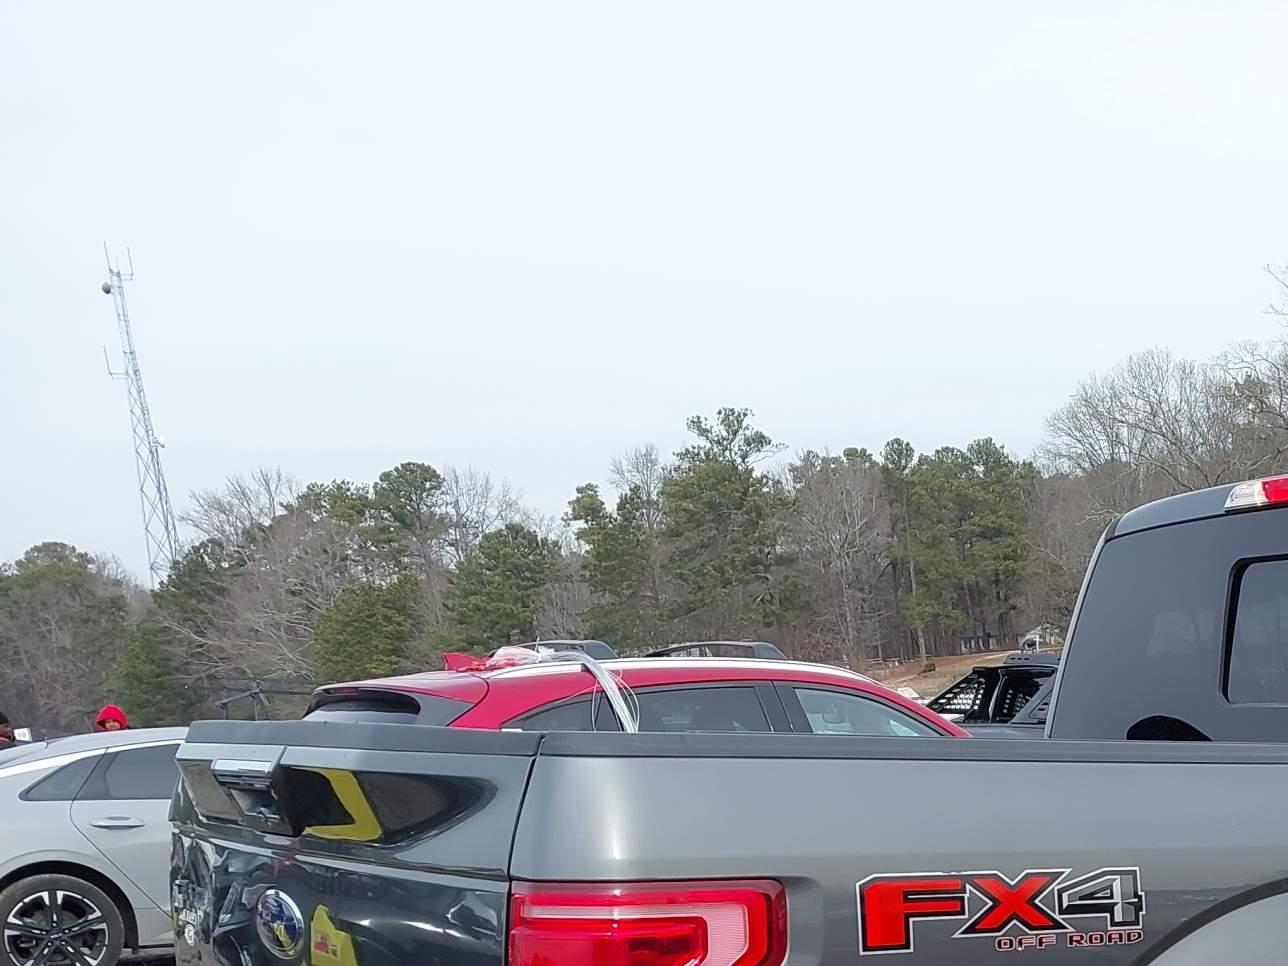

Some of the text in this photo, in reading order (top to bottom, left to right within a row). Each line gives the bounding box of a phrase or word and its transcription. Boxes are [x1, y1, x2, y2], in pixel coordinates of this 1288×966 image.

[855, 866, 1146, 955] FX4
[995, 928, 1146, 953] OFF ROAD
